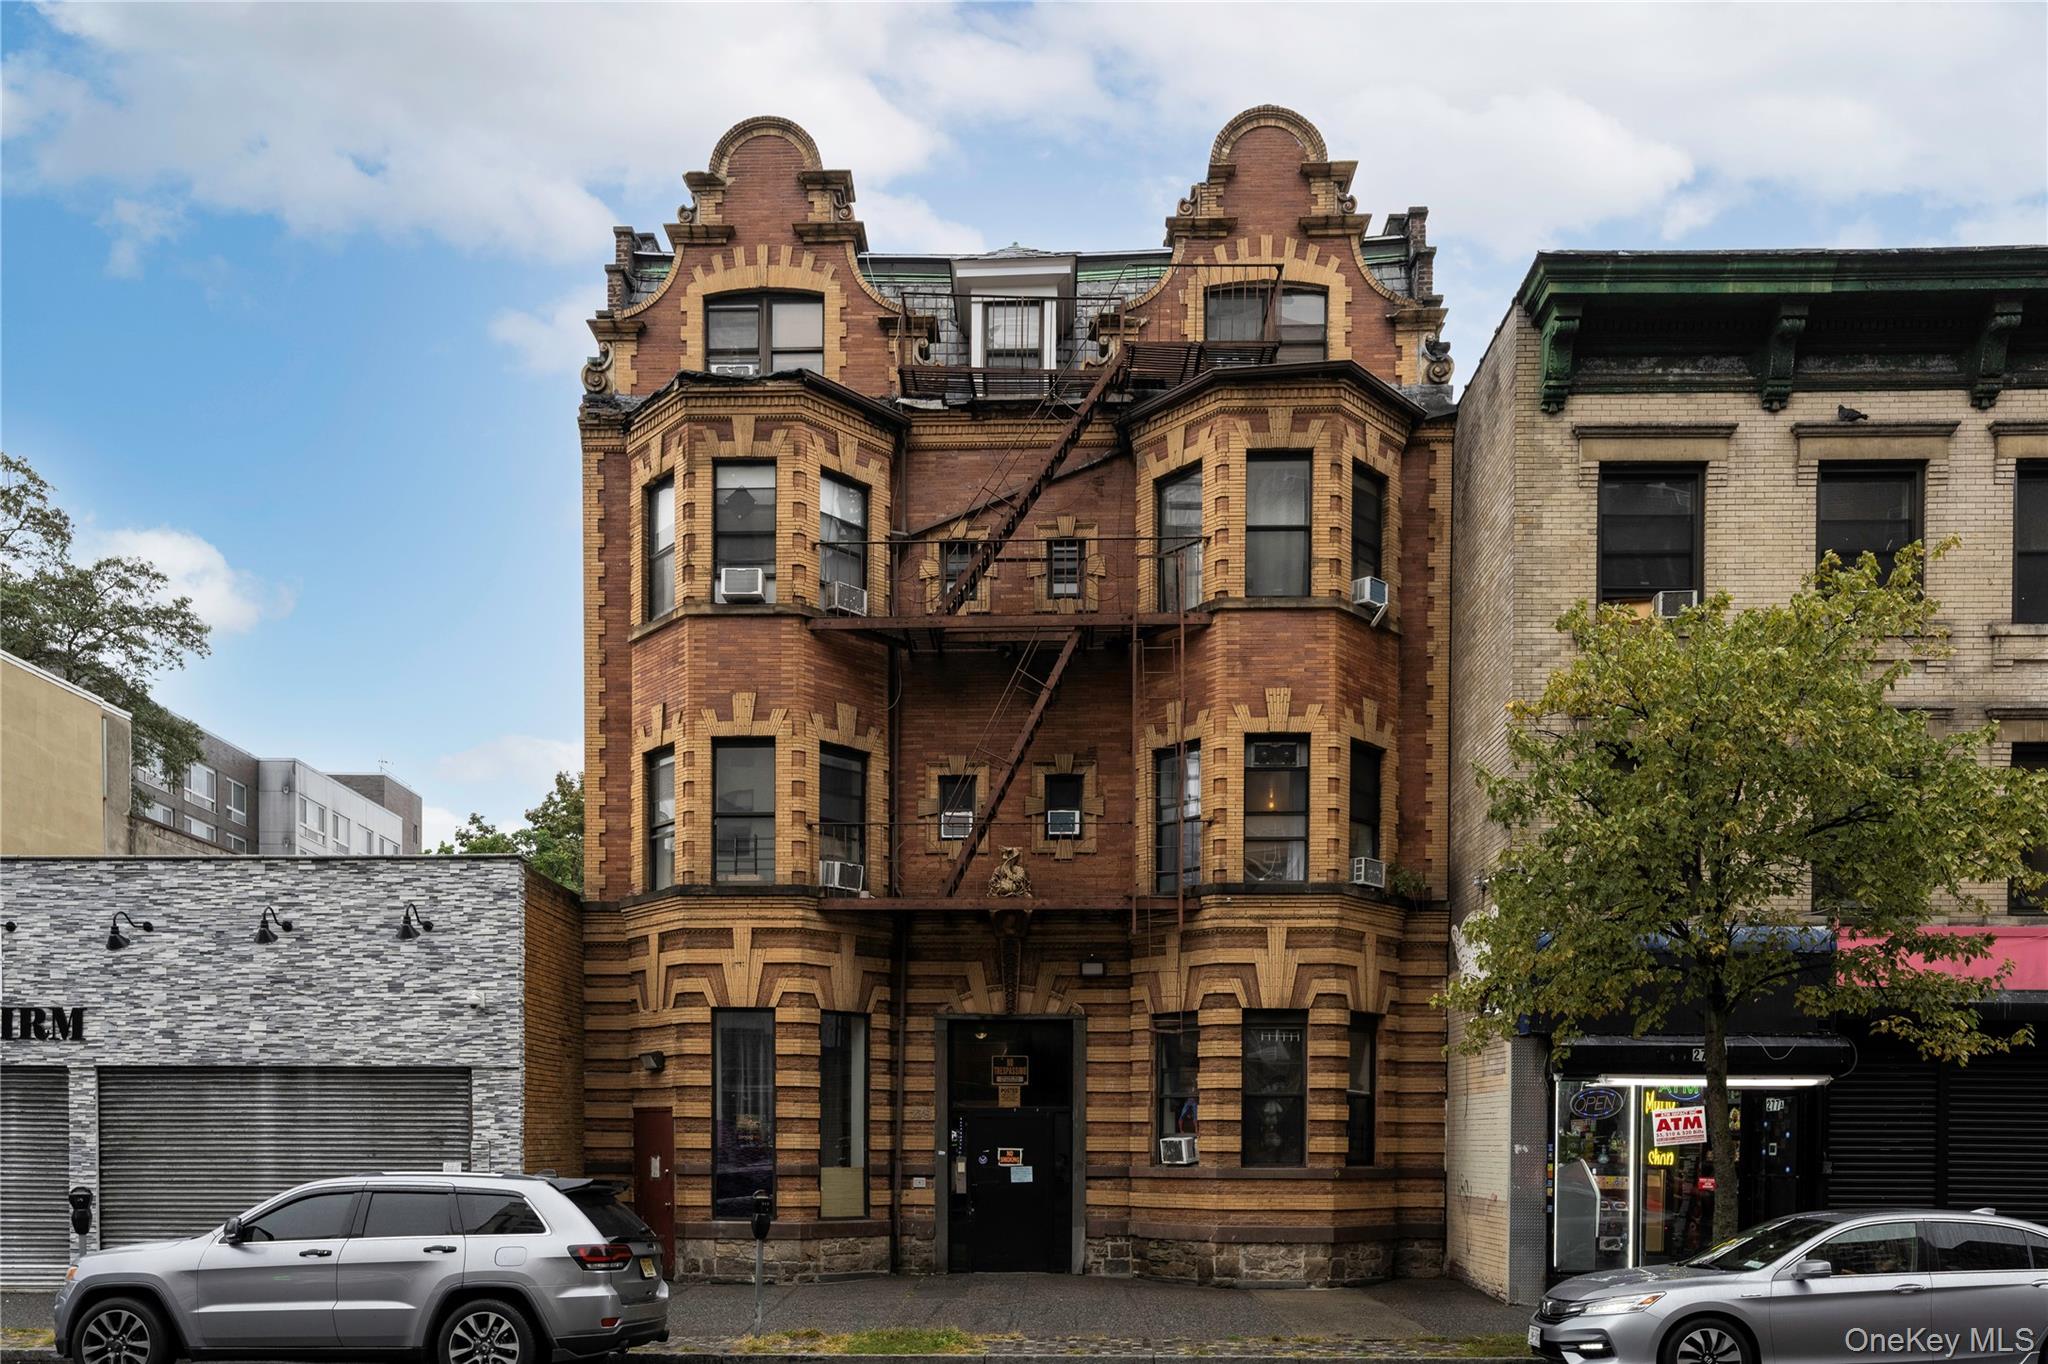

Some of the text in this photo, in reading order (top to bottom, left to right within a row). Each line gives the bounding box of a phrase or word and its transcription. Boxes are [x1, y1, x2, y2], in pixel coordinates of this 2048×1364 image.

[0, 1007, 87, 1041] IRM
[1573, 1095, 1616, 1112] OPEN
[1656, 1115, 1703, 1132] ATM
